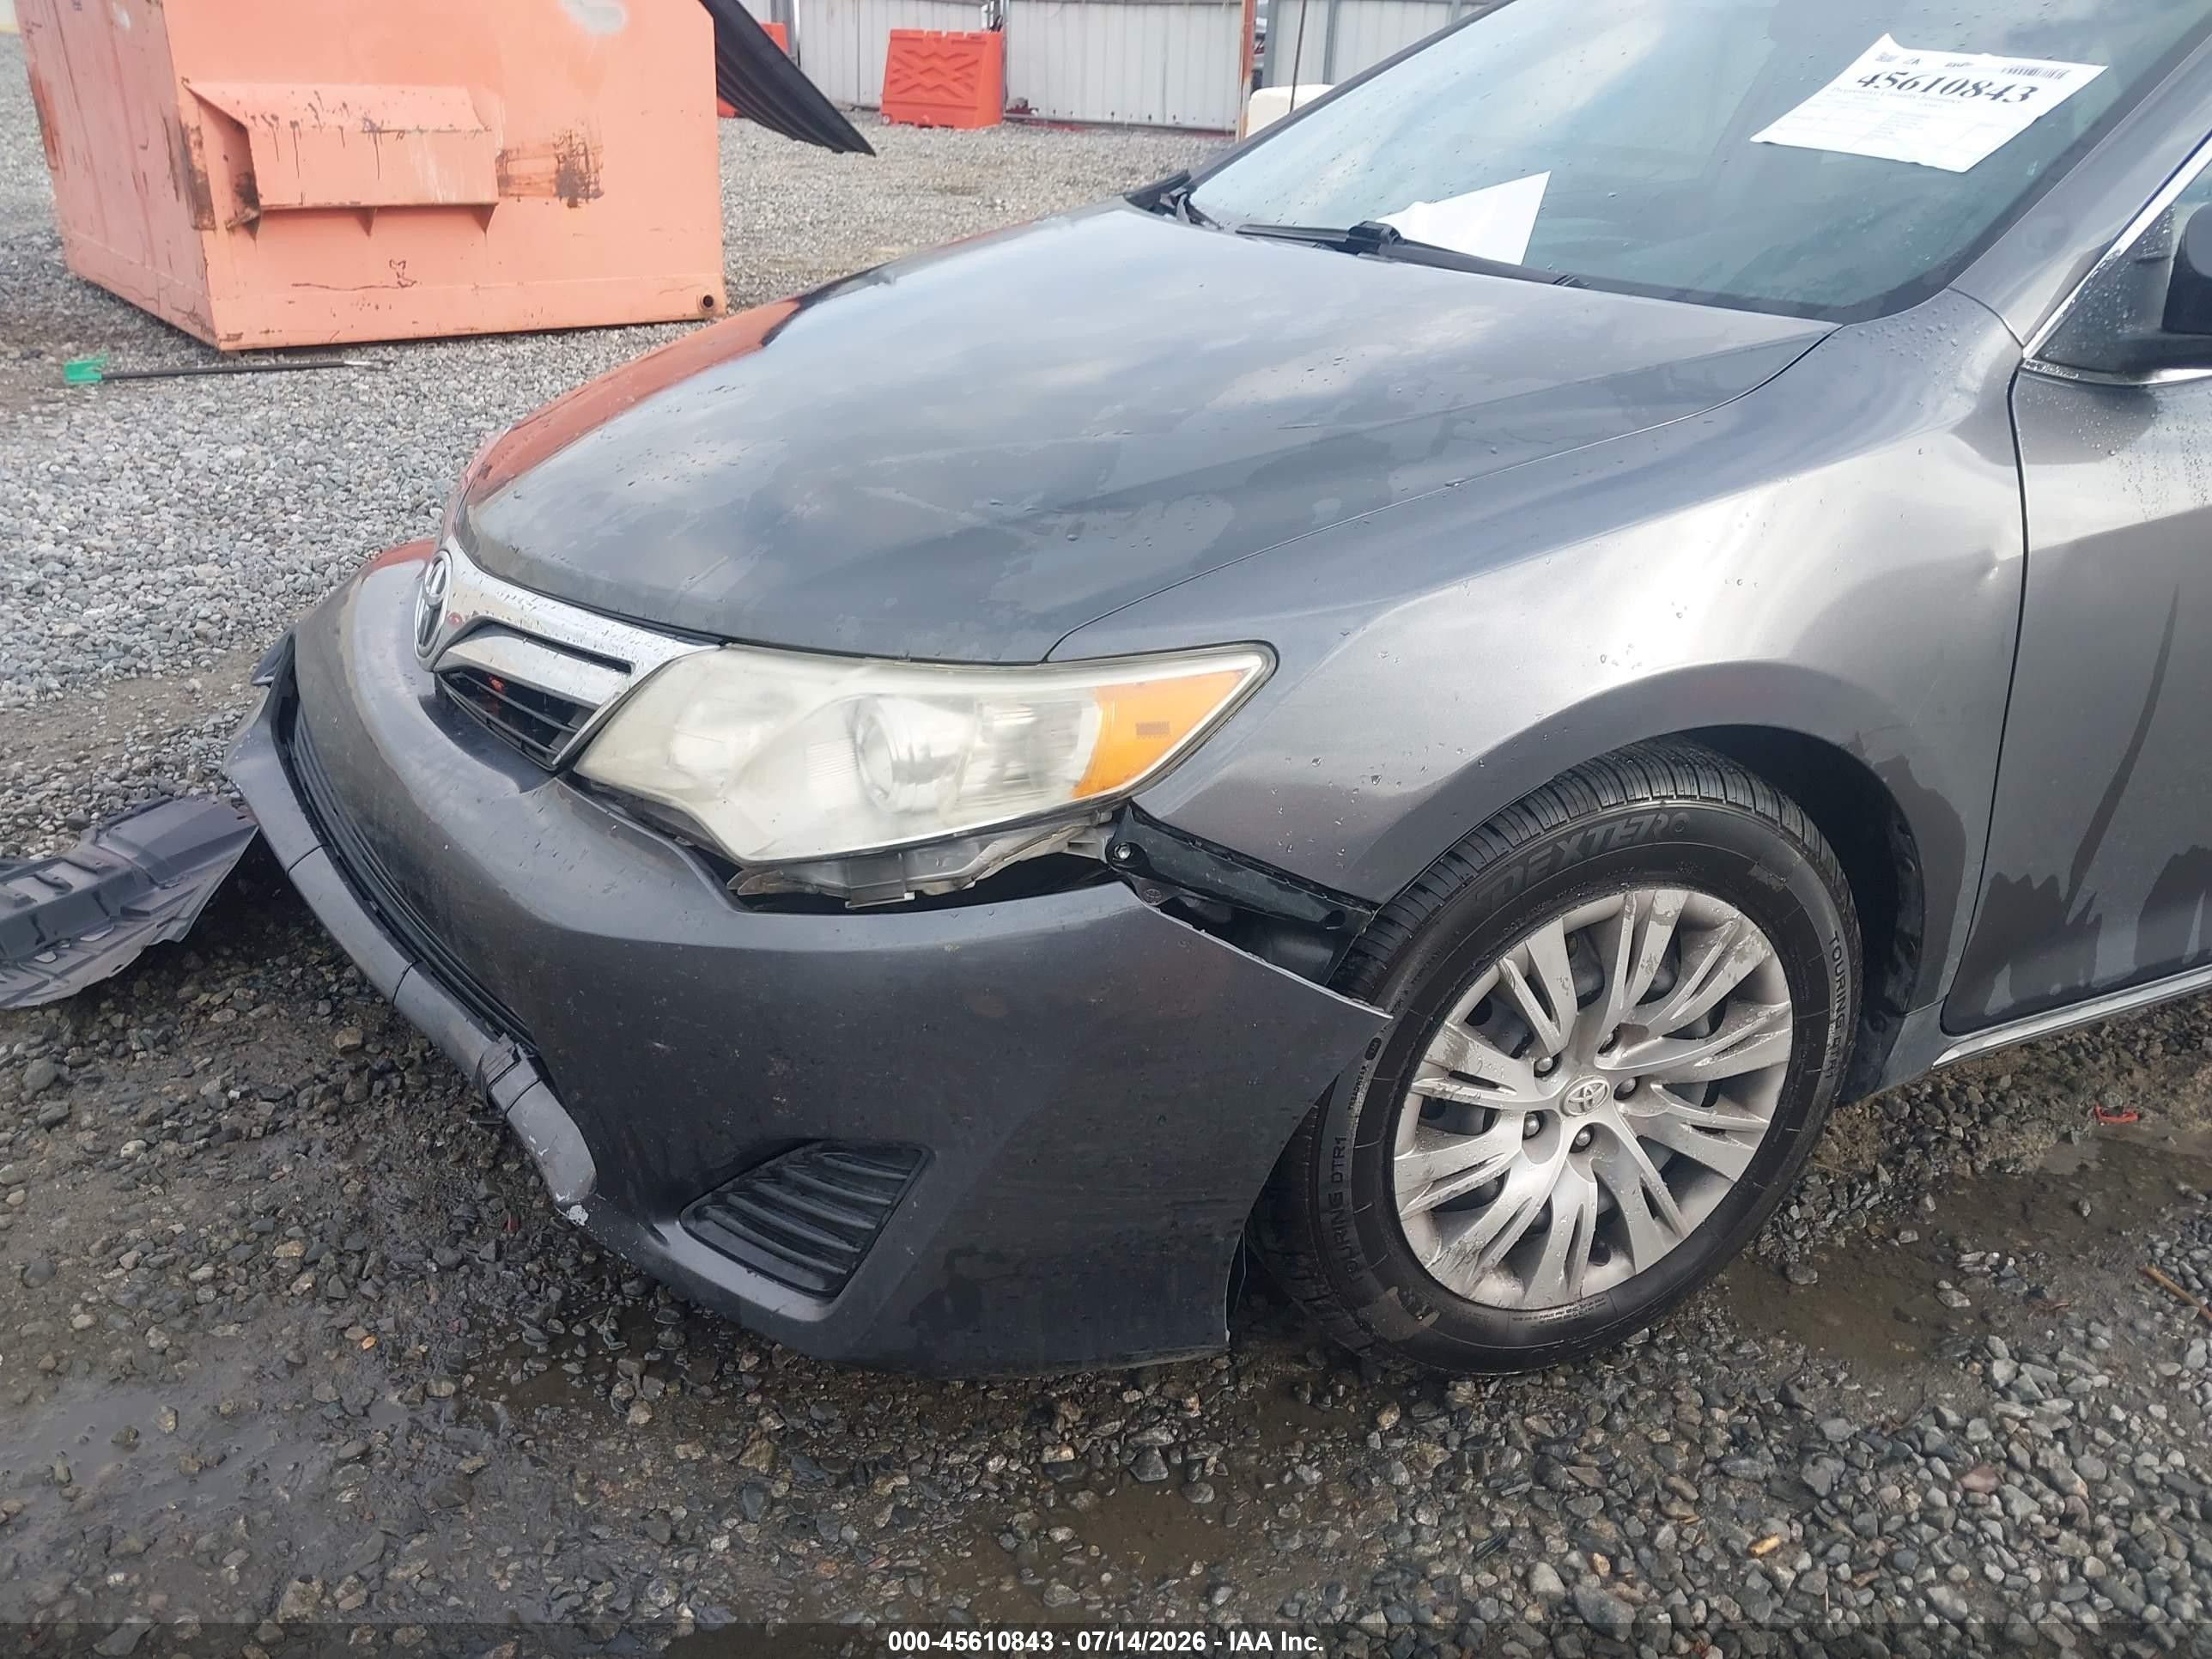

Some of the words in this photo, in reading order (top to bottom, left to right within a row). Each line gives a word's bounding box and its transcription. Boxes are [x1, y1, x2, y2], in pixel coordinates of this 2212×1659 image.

[1856, 71, 2039, 103] 45610843
[1828, 931, 1846, 1029] TOURING
[1330, 1136, 1347, 1183] DTR1
[1328, 1191, 1364, 1283] TOURING
